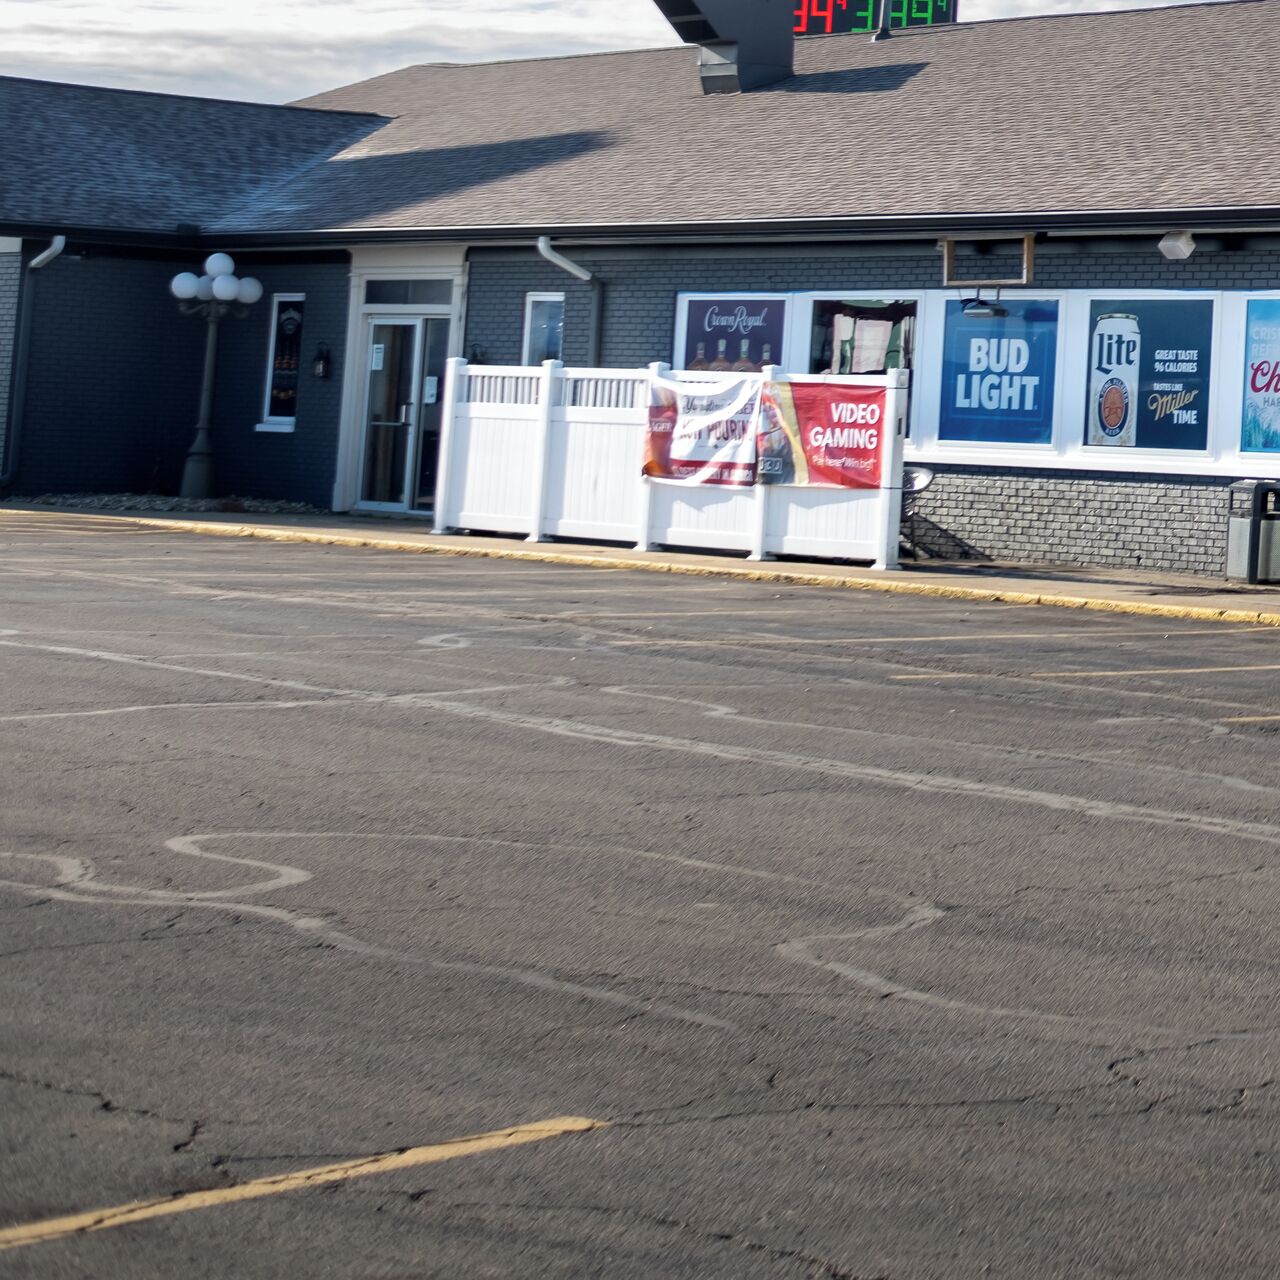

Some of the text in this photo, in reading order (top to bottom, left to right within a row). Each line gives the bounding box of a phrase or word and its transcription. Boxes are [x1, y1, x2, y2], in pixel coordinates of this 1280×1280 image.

[704, 305, 768, 334] Crown Royal
[968, 337, 1030, 373] BUD
[1096, 332, 1137, 375] Lite
[1155, 350, 1198, 360] GREAT TASTE
[1154, 362, 1198, 372] 96 CALORIES
[955, 374, 1040, 411] LIGHT
[1147, 389, 1199, 421] Miller
[831, 403, 880, 424] VIDEO
[1172, 410, 1198, 424] TIME
[810, 426, 878, 449] GAMING
